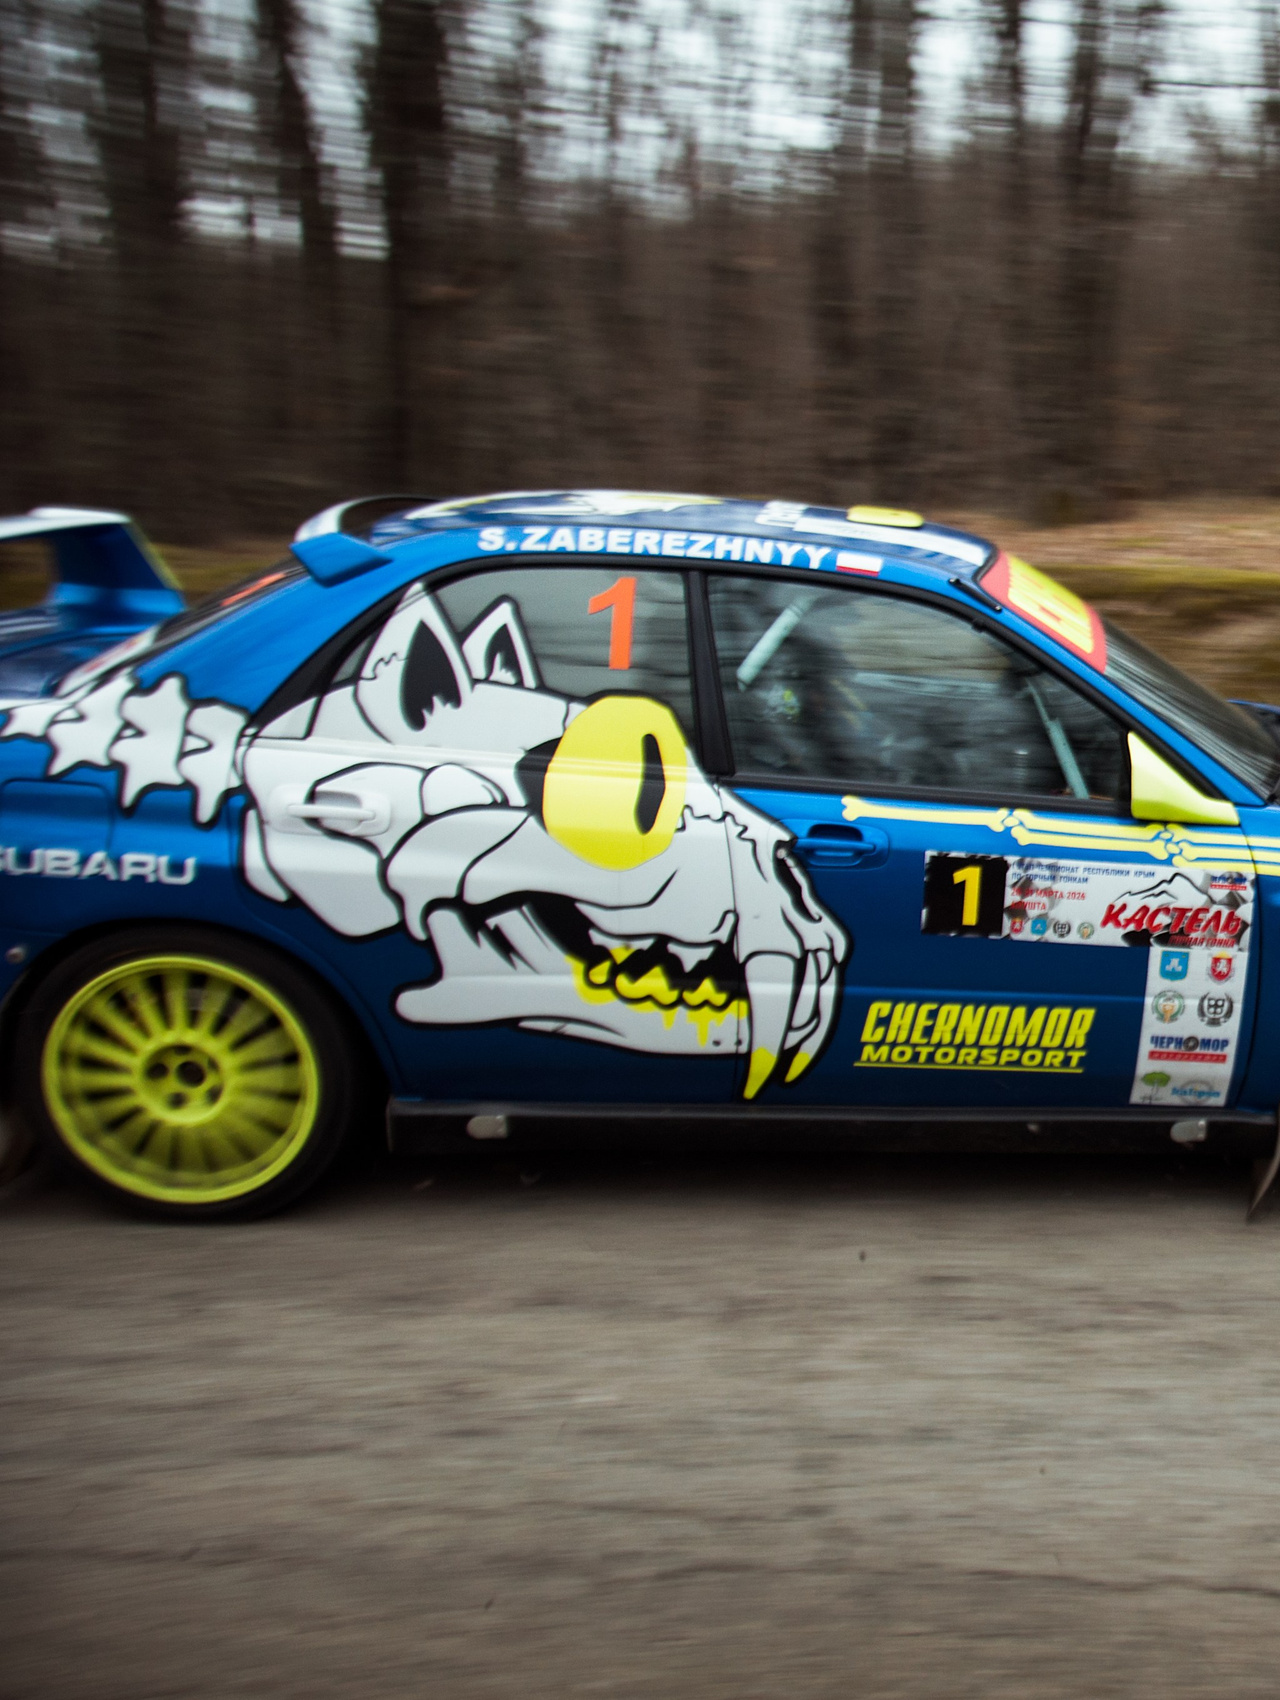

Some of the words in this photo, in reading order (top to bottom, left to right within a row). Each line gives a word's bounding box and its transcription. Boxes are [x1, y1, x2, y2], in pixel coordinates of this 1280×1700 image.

[477, 527, 831, 570] S.ZABEREZHNYY
[588, 577, 637, 670] 1
[0, 846, 197, 885] UBARU
[1059, 875, 1089, 884] ГОНКАМ
[1082, 867, 1130, 877] РЕСПУБЛИКИ
[952, 866, 982, 926] 1
[1100, 902, 1242, 937] КАСТЕЛЬ
[860, 1001, 1096, 1049] CHERNOMOR
[860, 1045, 1087, 1068] MOTORSPORT
